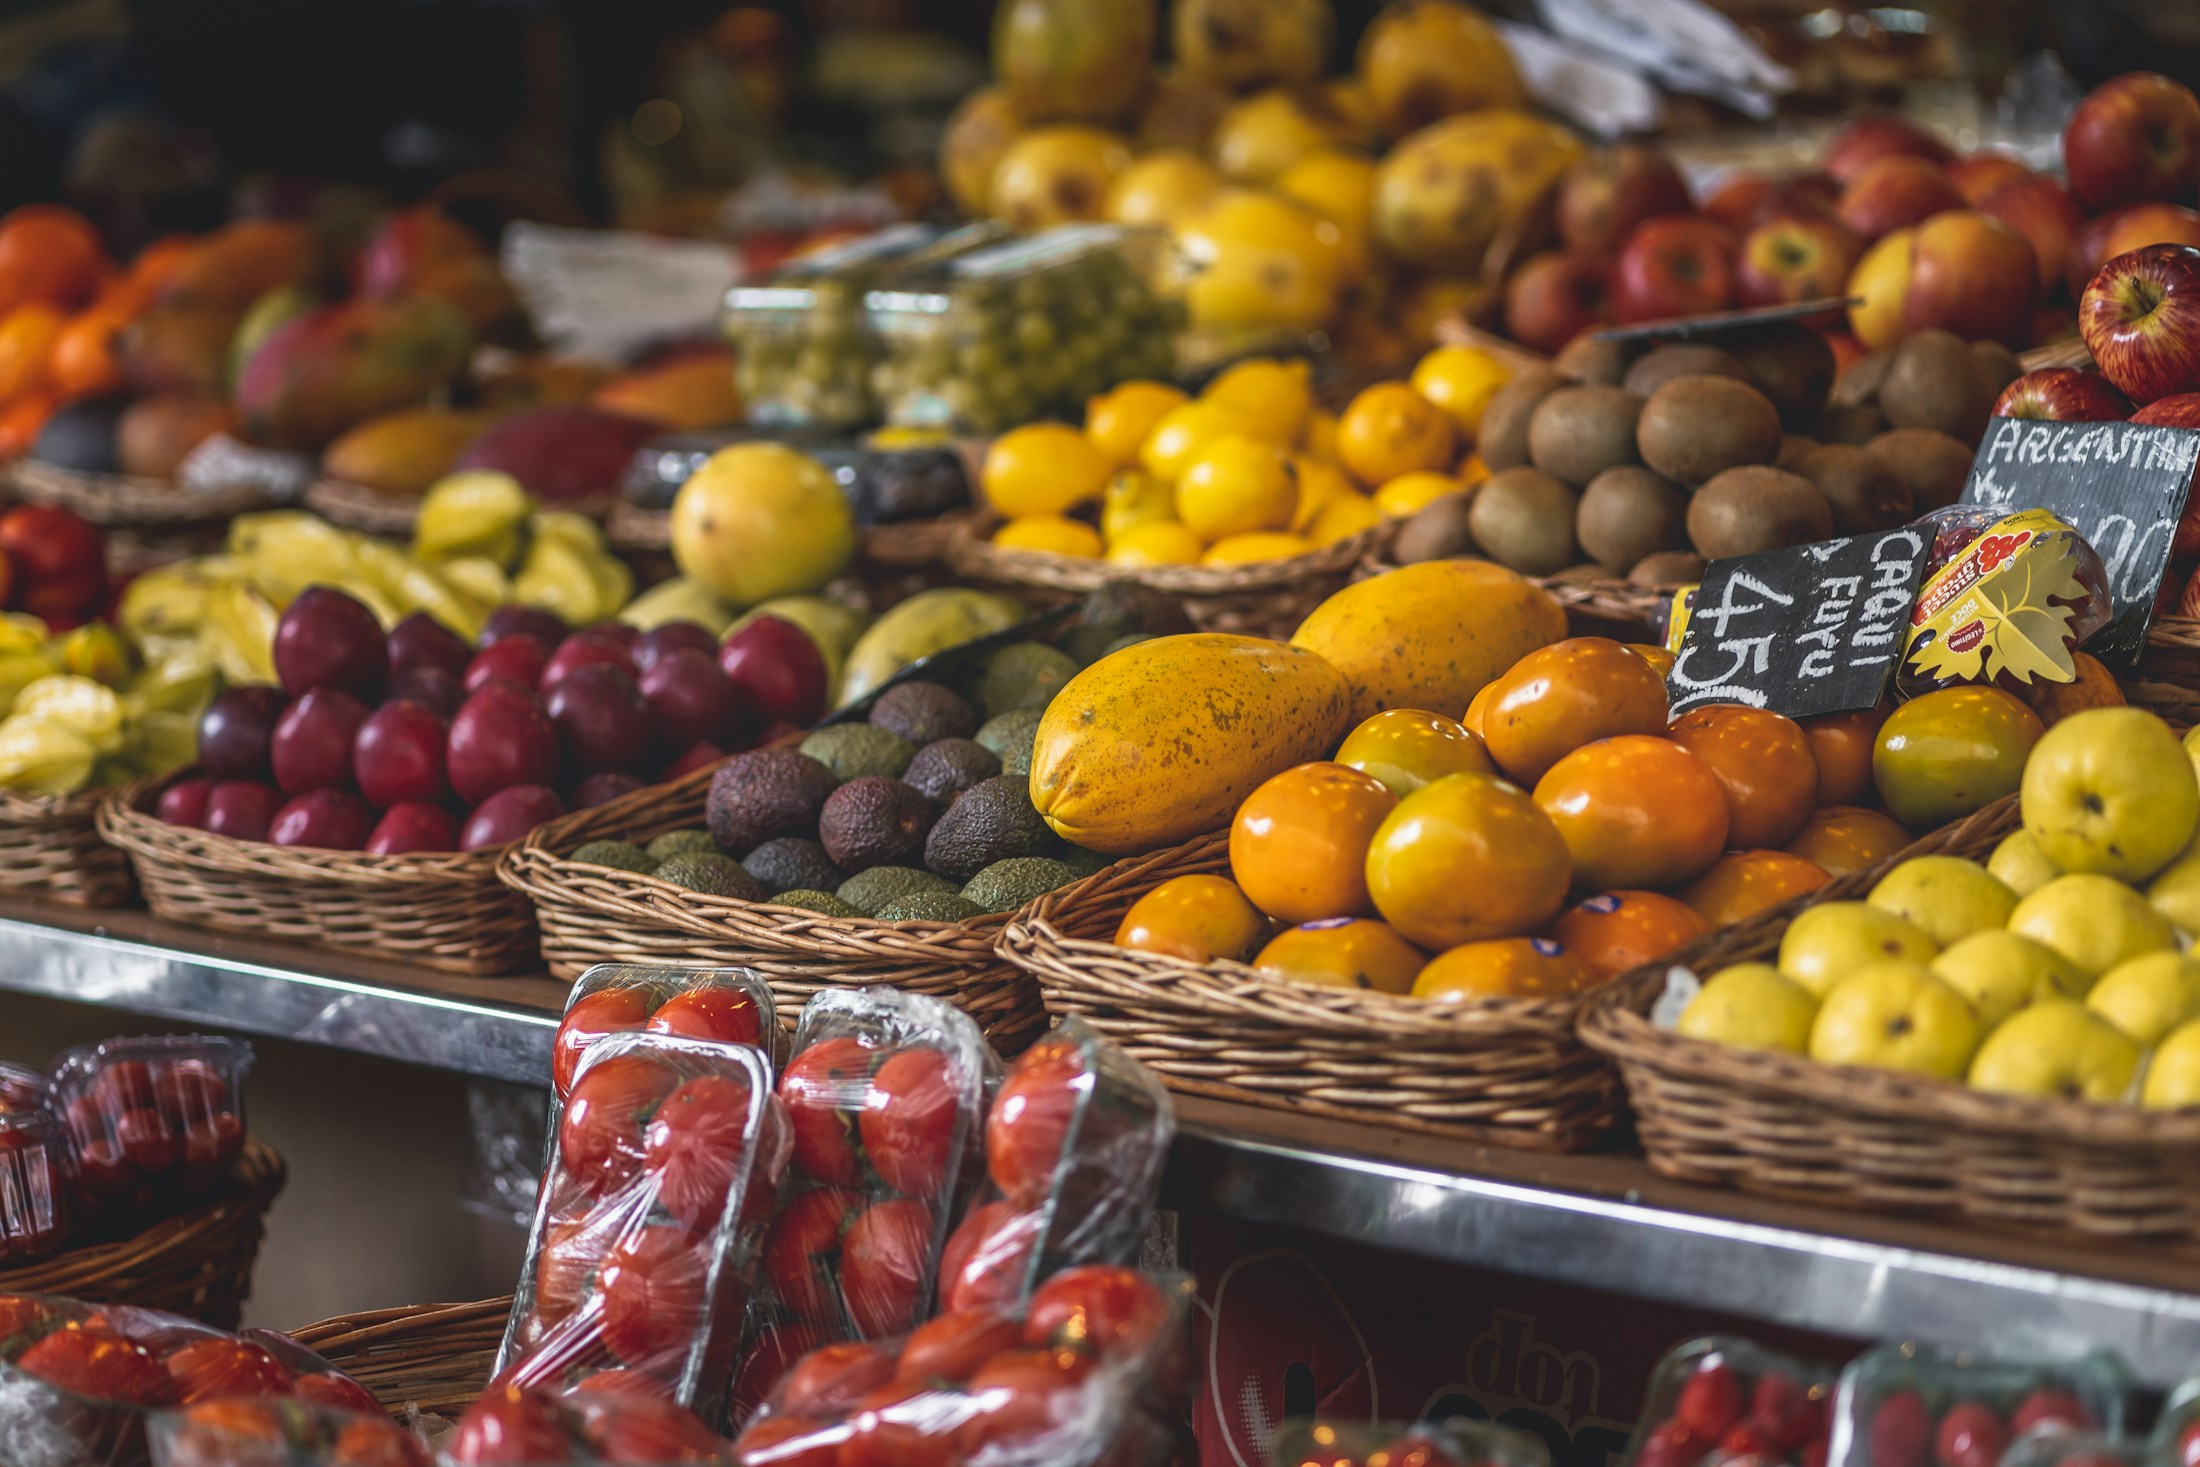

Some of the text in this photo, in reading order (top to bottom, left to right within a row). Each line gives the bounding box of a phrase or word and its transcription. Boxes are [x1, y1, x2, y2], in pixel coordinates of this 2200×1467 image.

[1849, 530, 1924, 667] CAQUI
[1920, 561, 1976, 611] grape
[1923, 569, 1977, 619] sweet
[1949, 598, 1977, 624] DOCE
[1794, 575, 1863, 679] FUYU
[1950, 630, 1980, 649] LEGÍTIMO
